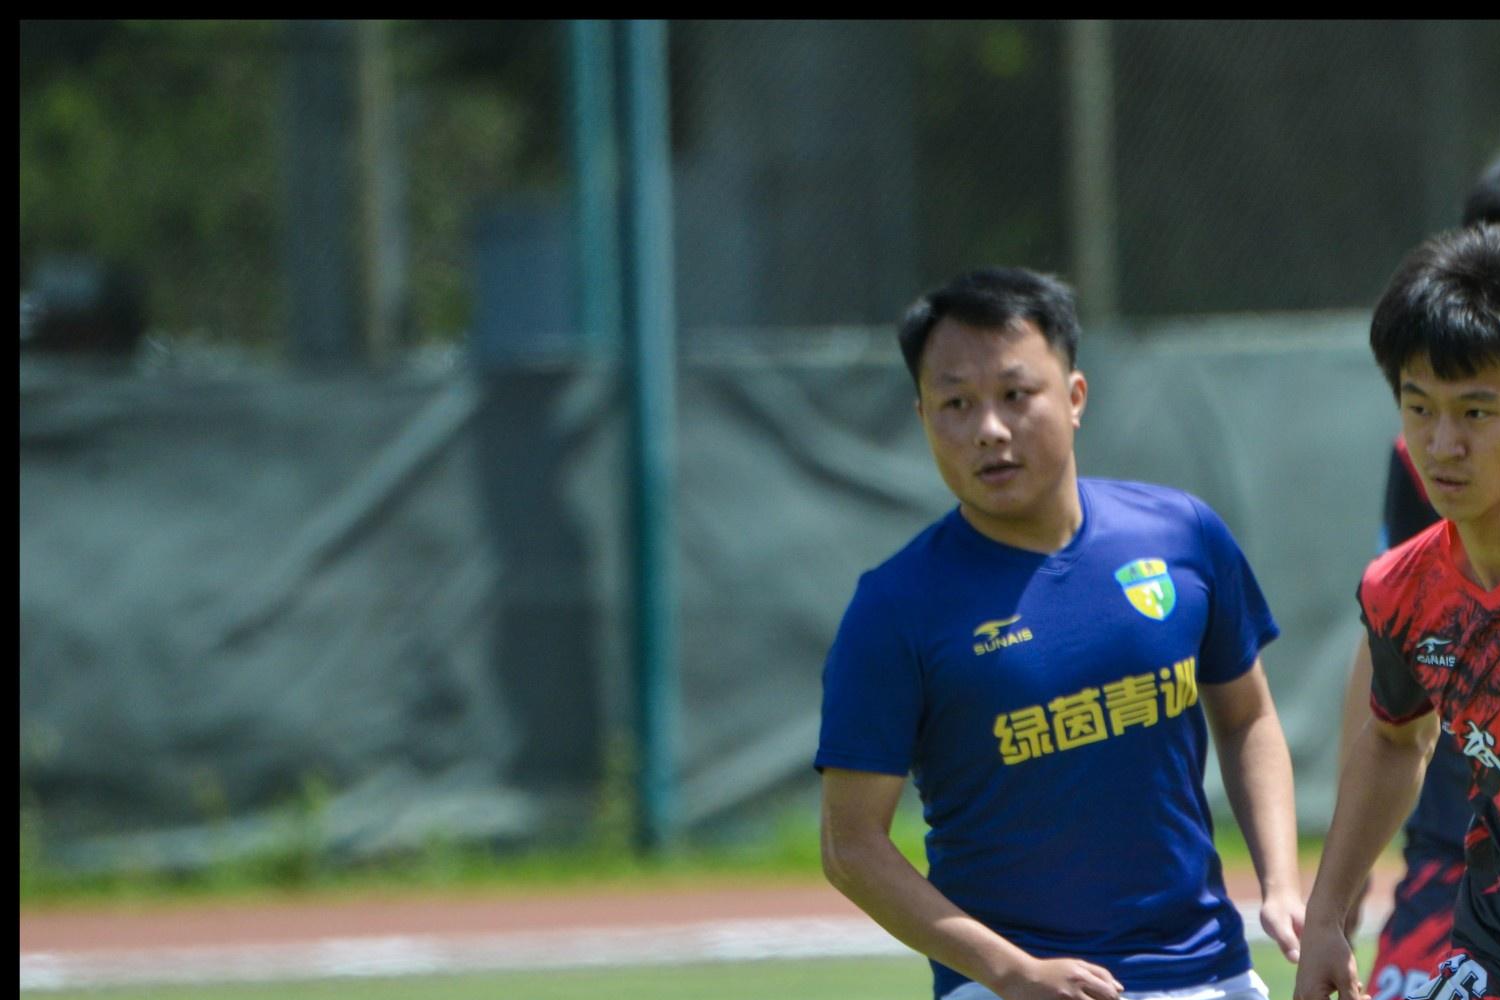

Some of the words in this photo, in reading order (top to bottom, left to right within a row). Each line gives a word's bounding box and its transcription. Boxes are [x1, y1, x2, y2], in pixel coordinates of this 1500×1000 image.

[974, 627, 1033, 656] SUNAIS
[993, 656, 1198, 766] 绿茵青训
